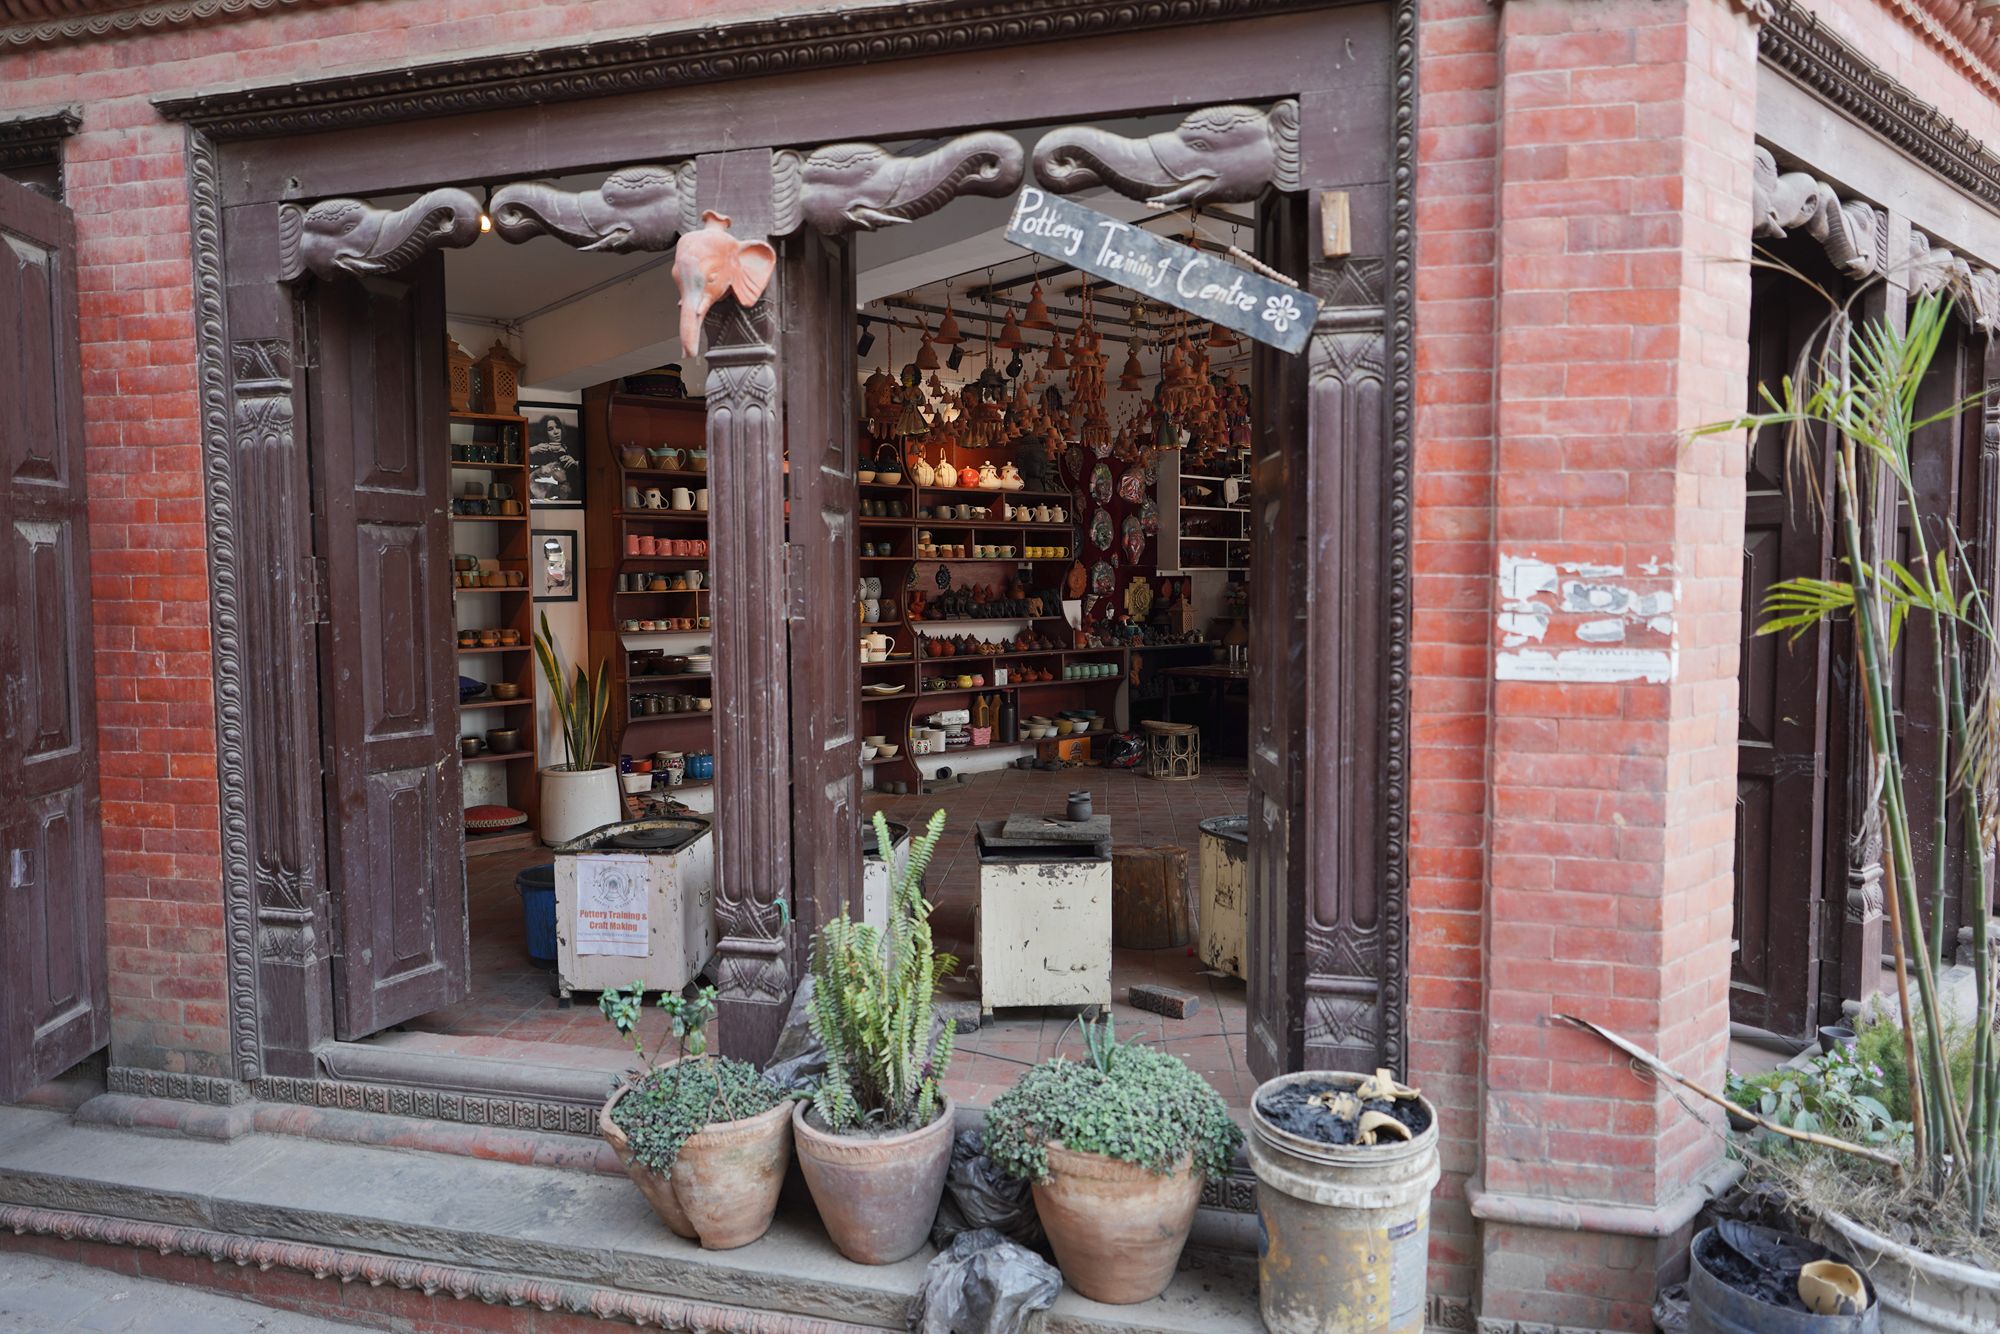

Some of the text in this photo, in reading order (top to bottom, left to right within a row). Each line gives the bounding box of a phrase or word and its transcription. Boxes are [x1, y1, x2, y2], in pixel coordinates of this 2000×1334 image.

[1012, 190, 1258, 312] Pottery Training Centre
[579, 909, 648, 921] Pottery Training &
[589, 920, 638, 932] Craft Making
